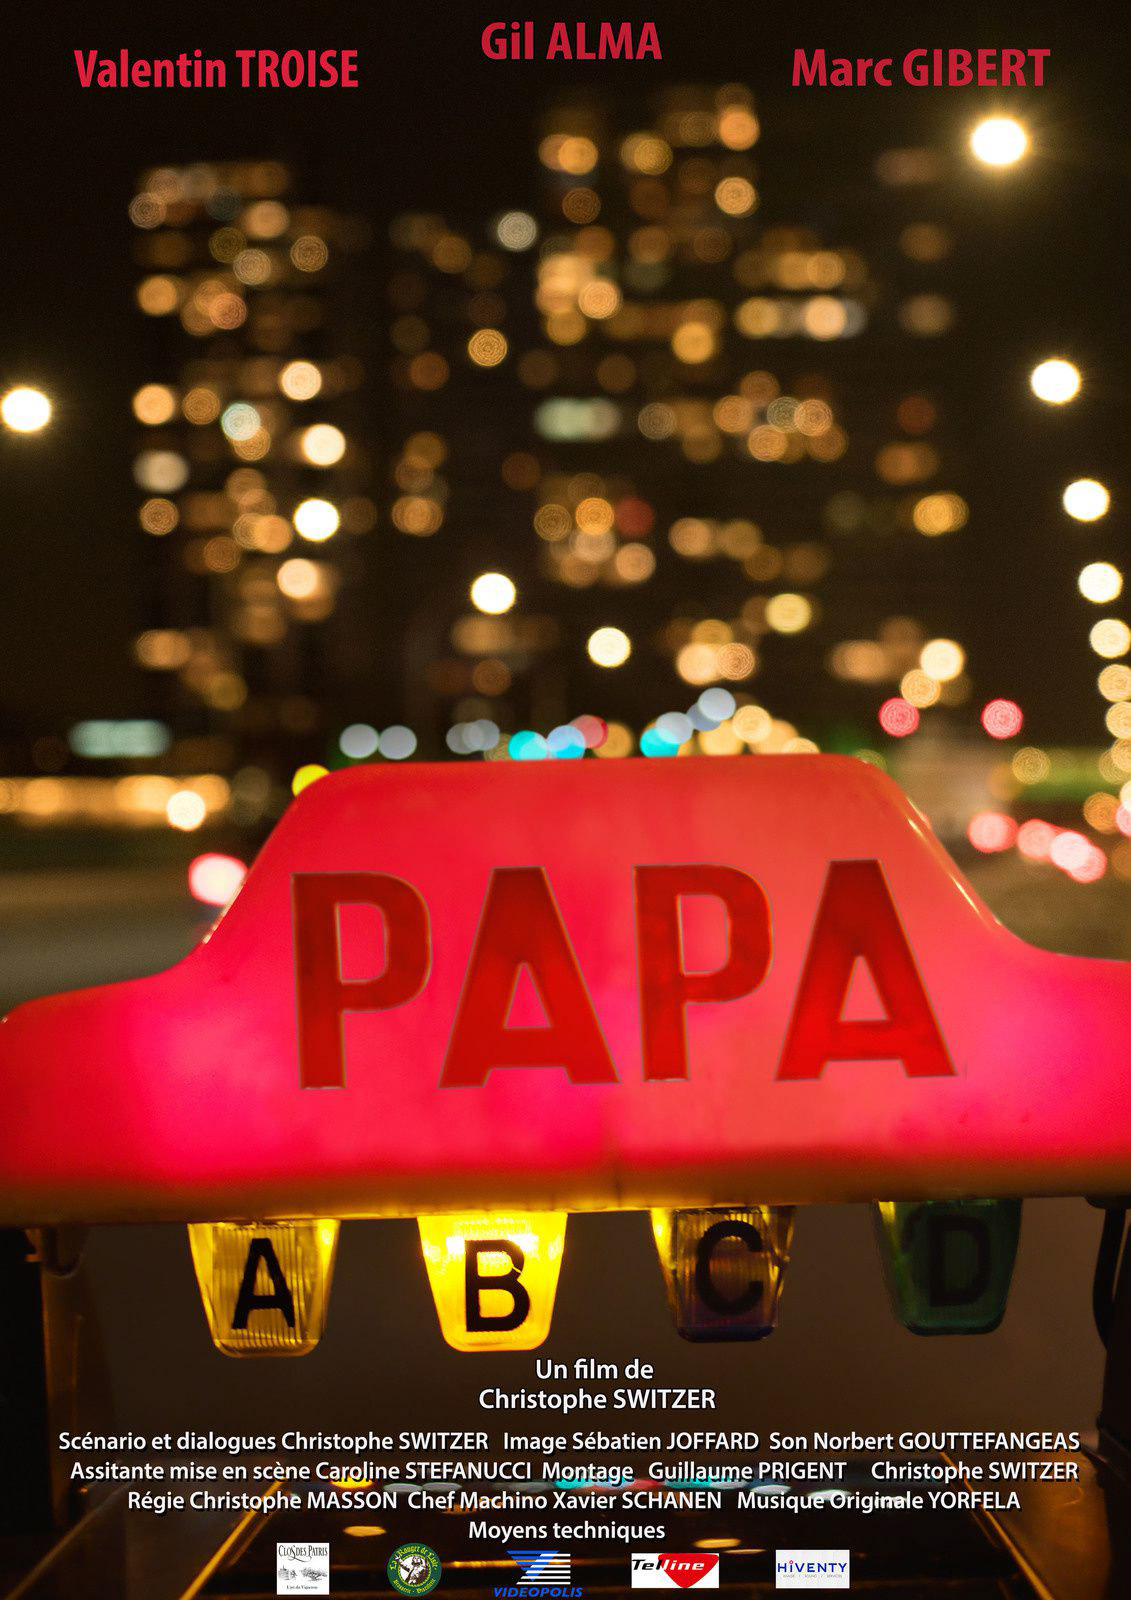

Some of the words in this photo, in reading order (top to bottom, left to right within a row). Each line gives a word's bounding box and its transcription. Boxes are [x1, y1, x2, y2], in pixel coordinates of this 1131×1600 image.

[481, 21, 534, 60] Gil
[546, 22, 663, 60] ALMA
[74, 48, 227, 88] Valentin
[236, 49, 359, 89] TROISE
[792, 48, 893, 87] Marc
[903, 48, 1051, 87] GIBERT
[290, 858, 957, 1090] PAPA
[695, 1221, 764, 1316] C
[928, 1213, 990, 1308] D
[231, 1236, 297, 1331] A
[463, 1238, 533, 1333] B
[536, 1359, 568, 1380] Un
[573, 1358, 618, 1379] film
[624, 1358, 654, 1380] de
[479, 1388, 607, 1414] Christophe
[613, 1388, 716, 1409] SWITZER
[59, 1431, 147, 1450] Scénario
[151, 1433, 172, 1450] et
[176, 1431, 277, 1455] dialogues
[281, 1431, 394, 1454] Christophe
[398, 1432, 489, 1450] SWITZER
[504, 1432, 567, 1455] Image
[572, 1431, 661, 1450] Sébatien
[666, 1432, 759, 1450] JOFFARD
[769, 1431, 807, 1450] Son
[814, 1431, 894, 1450] Norbert
[898, 1432, 1080, 1450] GOUTTEFANGEAS
[70, 1461, 165, 1480] Assitante
[170, 1461, 217, 1480] mise
[222, 1466, 247, 1480] en
[253, 1461, 311, 1480] scène
[315, 1461, 400, 1480] Caroline
[405, 1462, 532, 1480] STEFANUCCI
[542, 1462, 634, 1485] Montage
[648, 1461, 753, 1480] Guillaume
[758, 1462, 847, 1480] PRIGENT
[871, 1461, 983, 1484] Christophe
[988, 1461, 1078, 1480] SWITZER
[128, 1490, 185, 1514] Régie
[189, 1490, 302, 1514] Christophe
[307, 1491, 397, 1509] MASSON
[407, 1490, 456, 1509] Chef
[460, 1490, 548, 1509] Machino
[552, 1491, 617, 1509] Xavier
[622, 1491, 722, 1509] SCHANEN
[737, 1490, 824, 1514] Musique
[829, 1490, 924, 1514] Originale
[927, 1491, 1021, 1509] YORFELA
[469, 1521, 548, 1544] Moyens
[552, 1520, 666, 1543] techniques
[631, 1559, 705, 1571] Telline
[493, 1587, 583, 1598] VIDEOPOLIS
